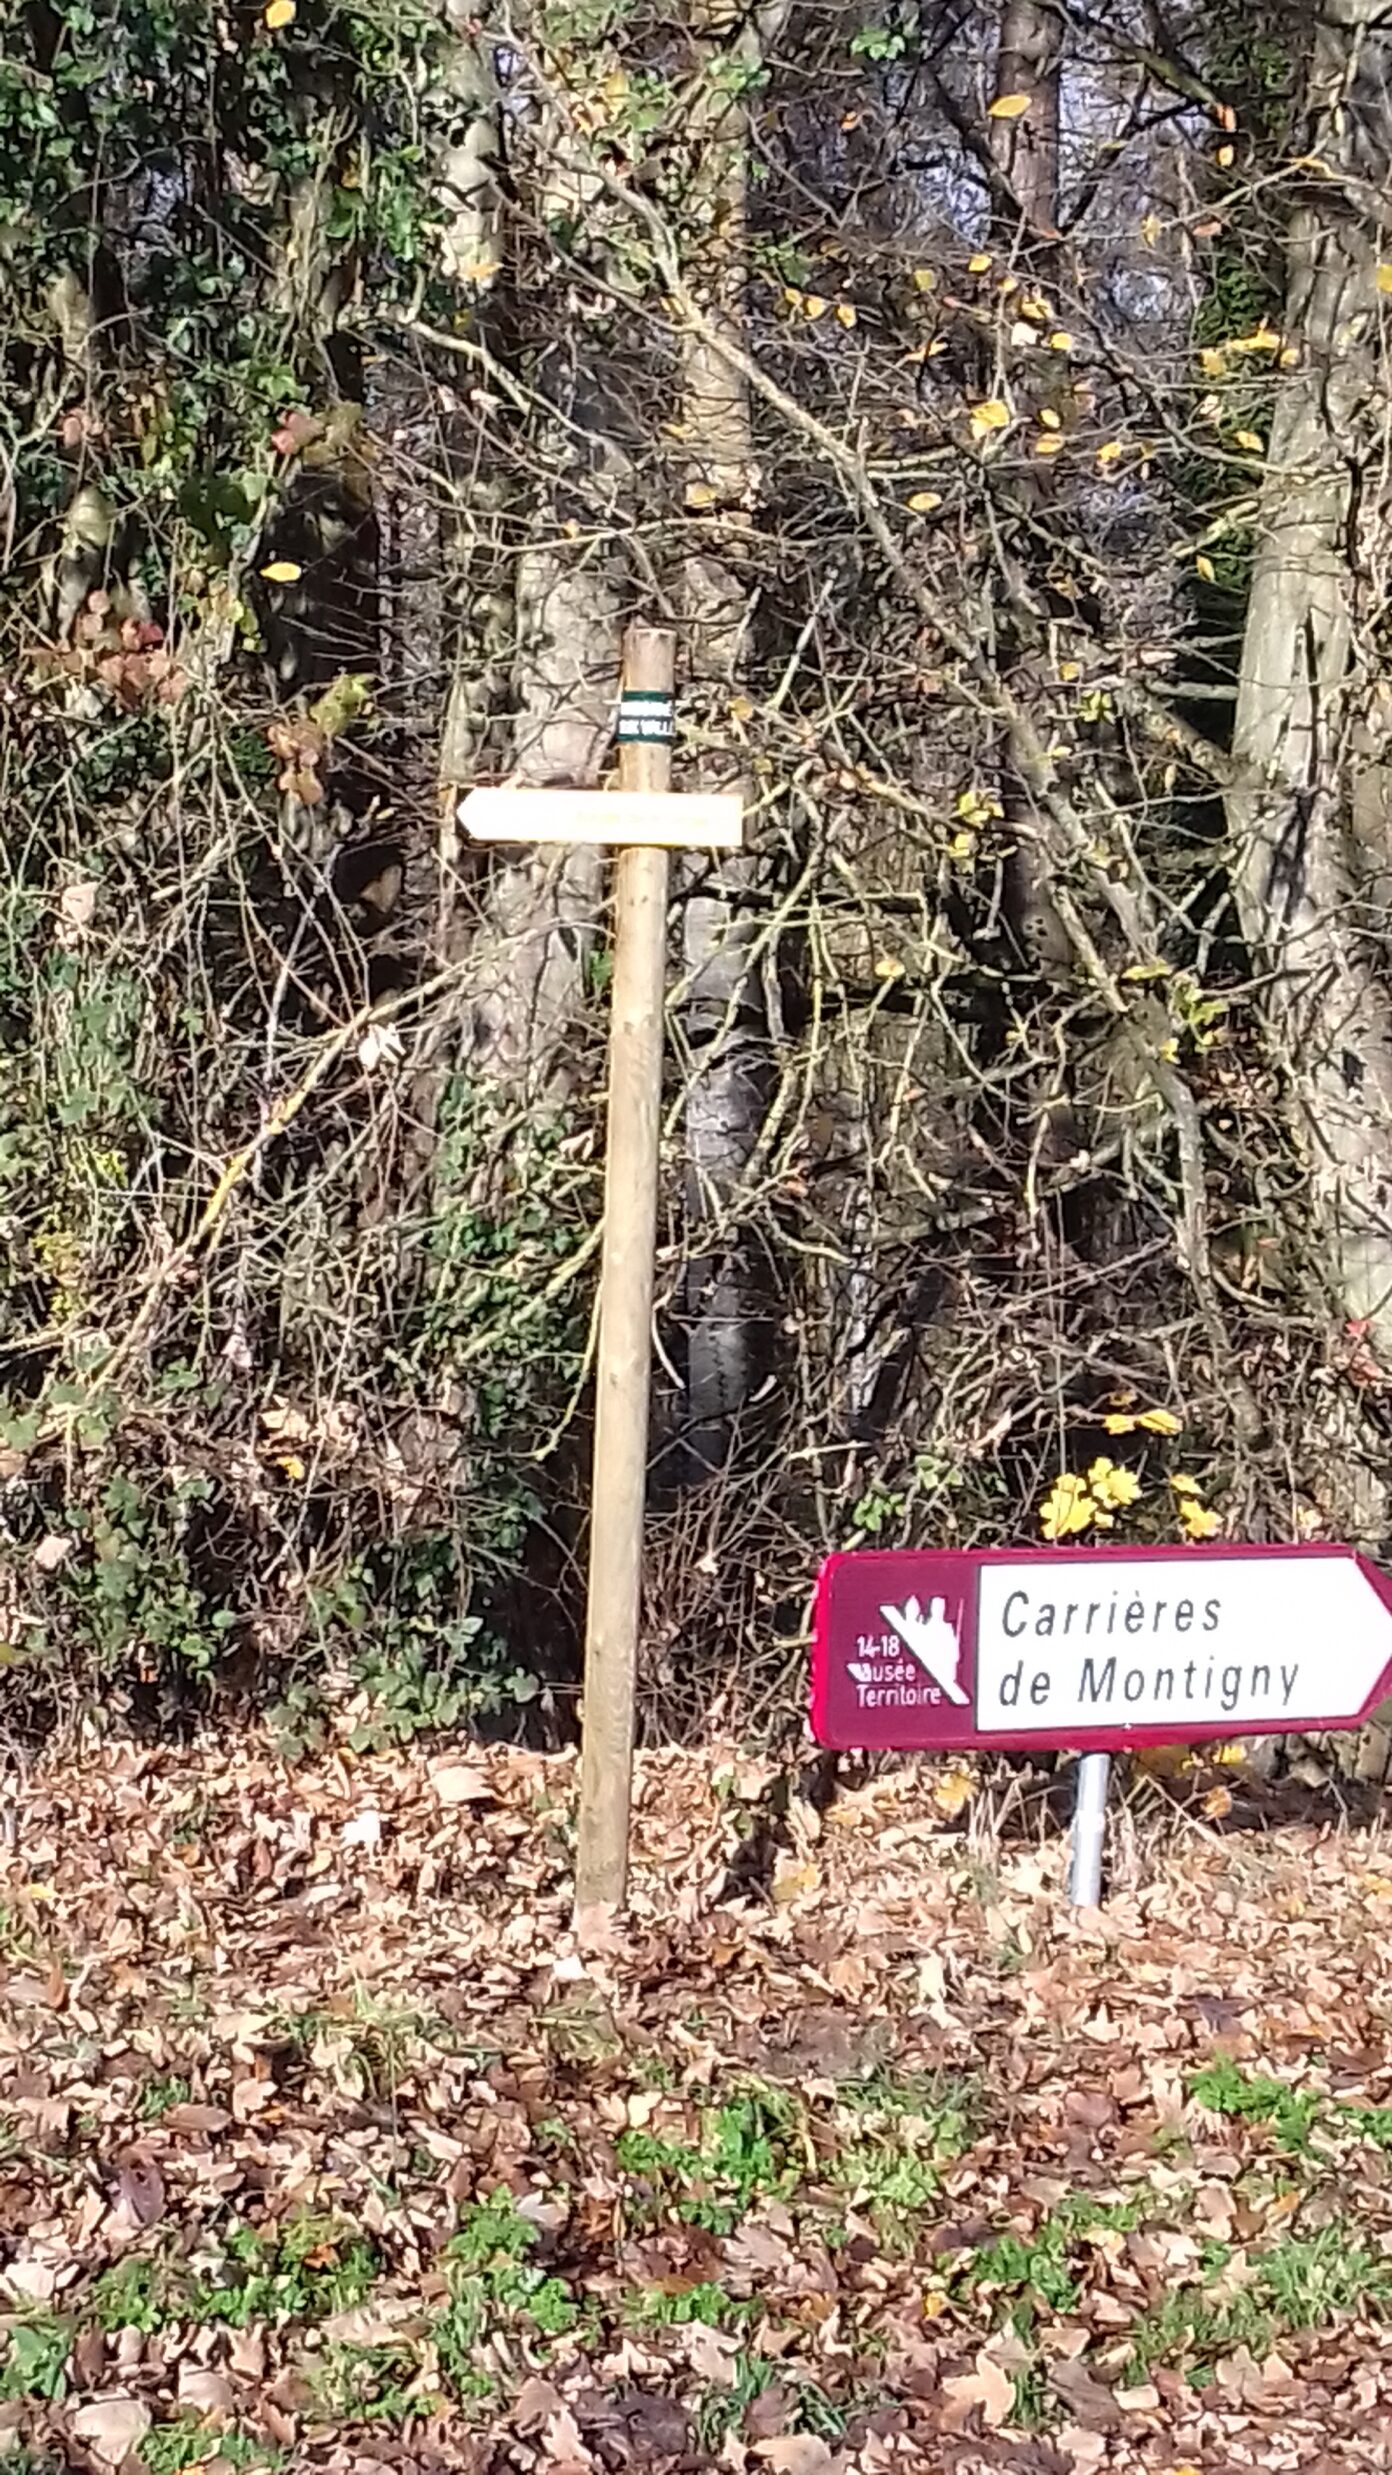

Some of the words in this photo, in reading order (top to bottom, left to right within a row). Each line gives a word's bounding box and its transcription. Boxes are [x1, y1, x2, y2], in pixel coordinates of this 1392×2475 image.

[1001, 1590, 1222, 1638] Carrières
[857, 1634, 900, 1658] 14-18
[856, 1682, 941, 1708] Territoire
[999, 1660, 1050, 1706] de
[1077, 1656, 1299, 1711] Montigny
